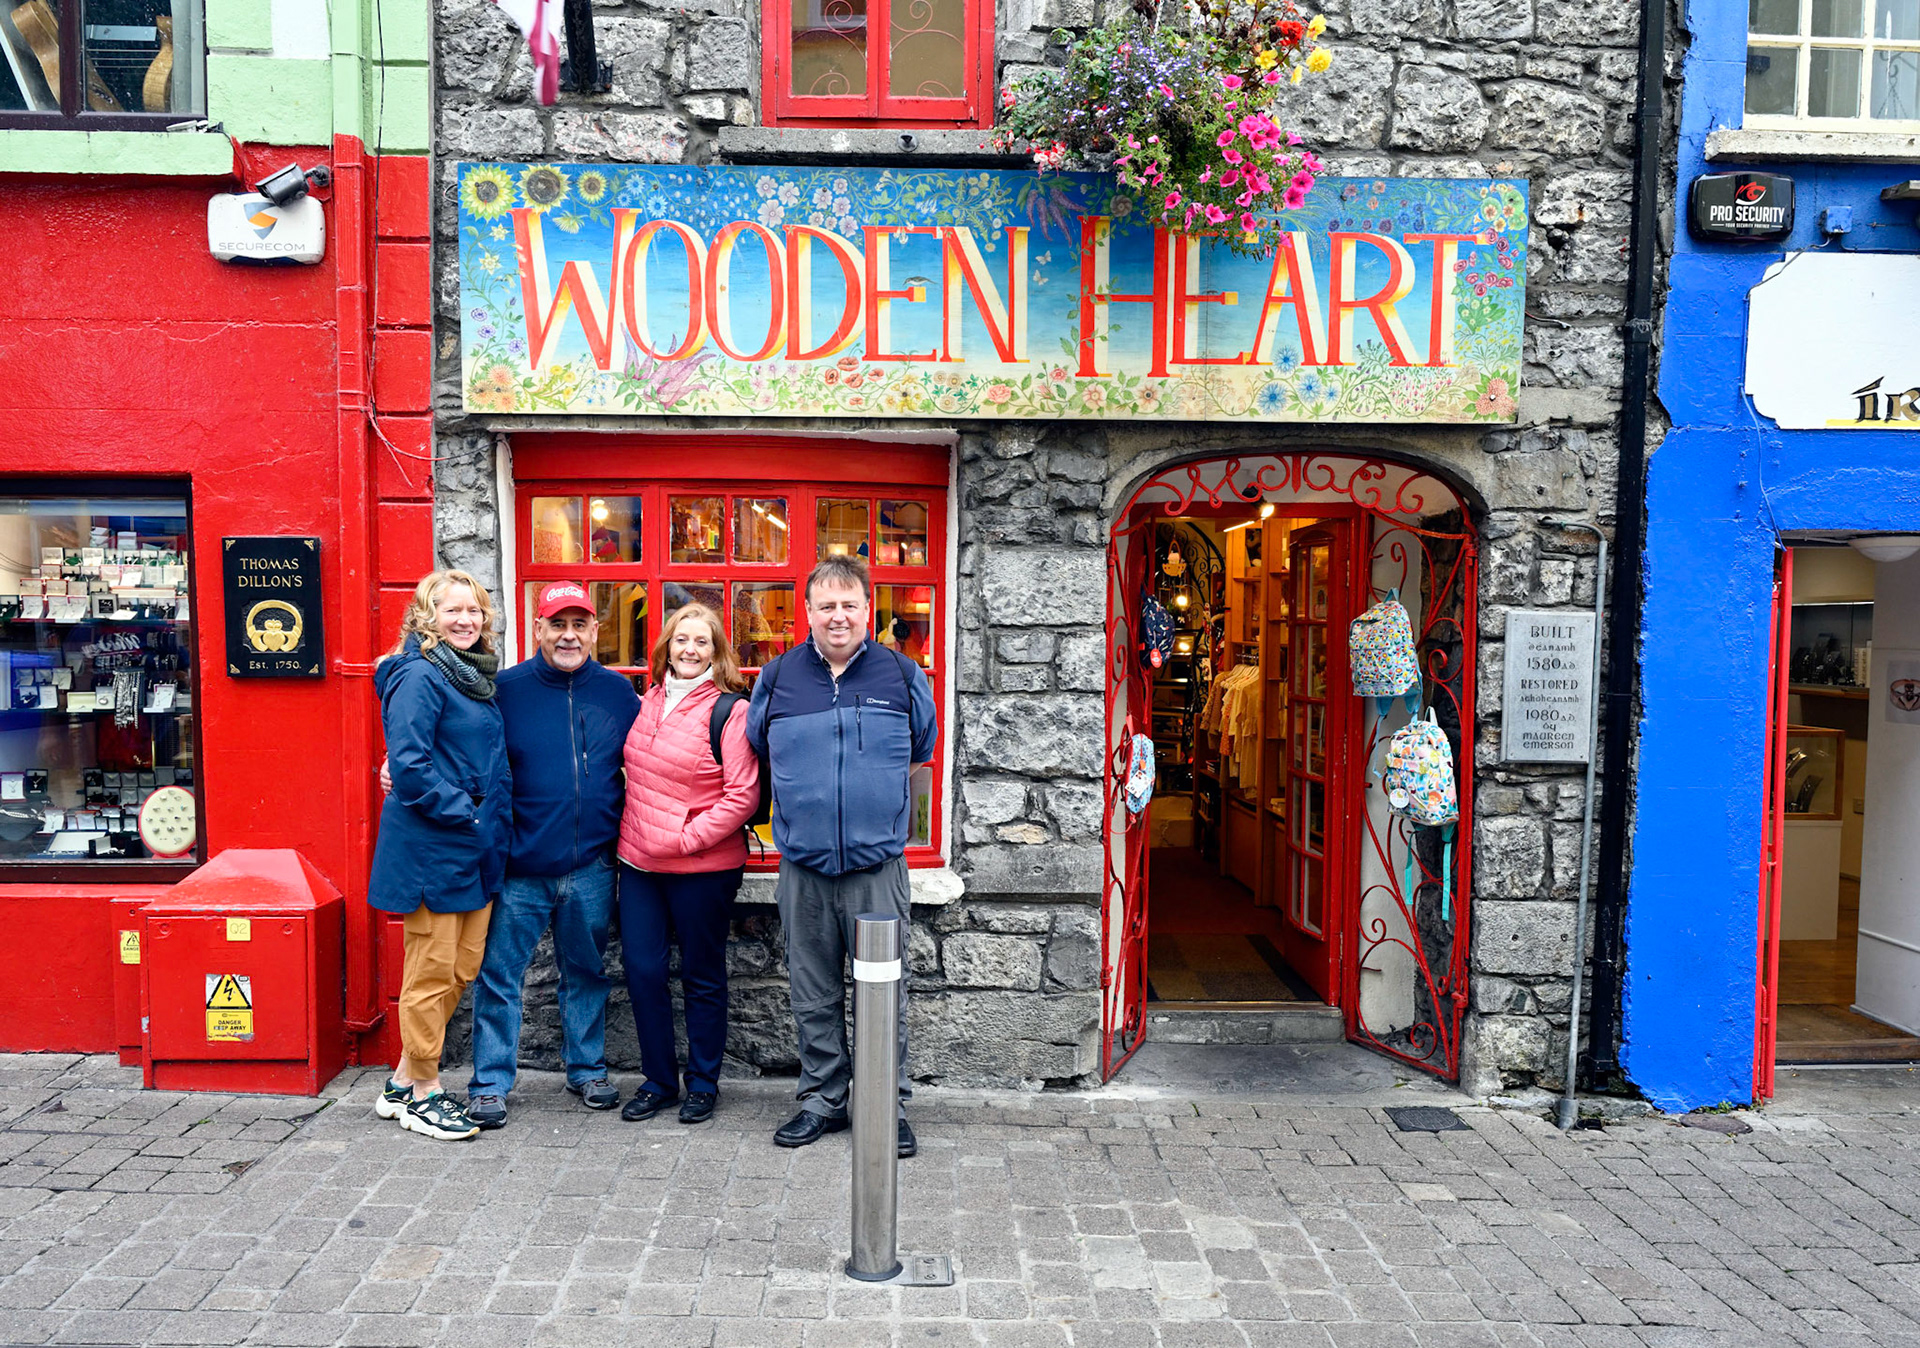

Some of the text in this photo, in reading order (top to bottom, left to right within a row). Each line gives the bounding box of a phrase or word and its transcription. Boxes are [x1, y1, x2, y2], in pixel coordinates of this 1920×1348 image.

[1709, 205, 1785, 223] PRO SECURITY
[218, 242, 306, 252] SECURECOM
[510, 207, 1490, 378] WOODEN HEART
[239, 557, 300, 570] THOMAS
[237, 575, 303, 588] DILLON'S
[1530, 625, 1576, 639] BUILT
[248, 660, 269, 670] Est.
[1527, 656, 1561, 671] 1580
[1521, 679, 1579, 690] RESTORED
[1526, 709, 1560, 721] 1980
[230, 922, 248, 935] Q2
